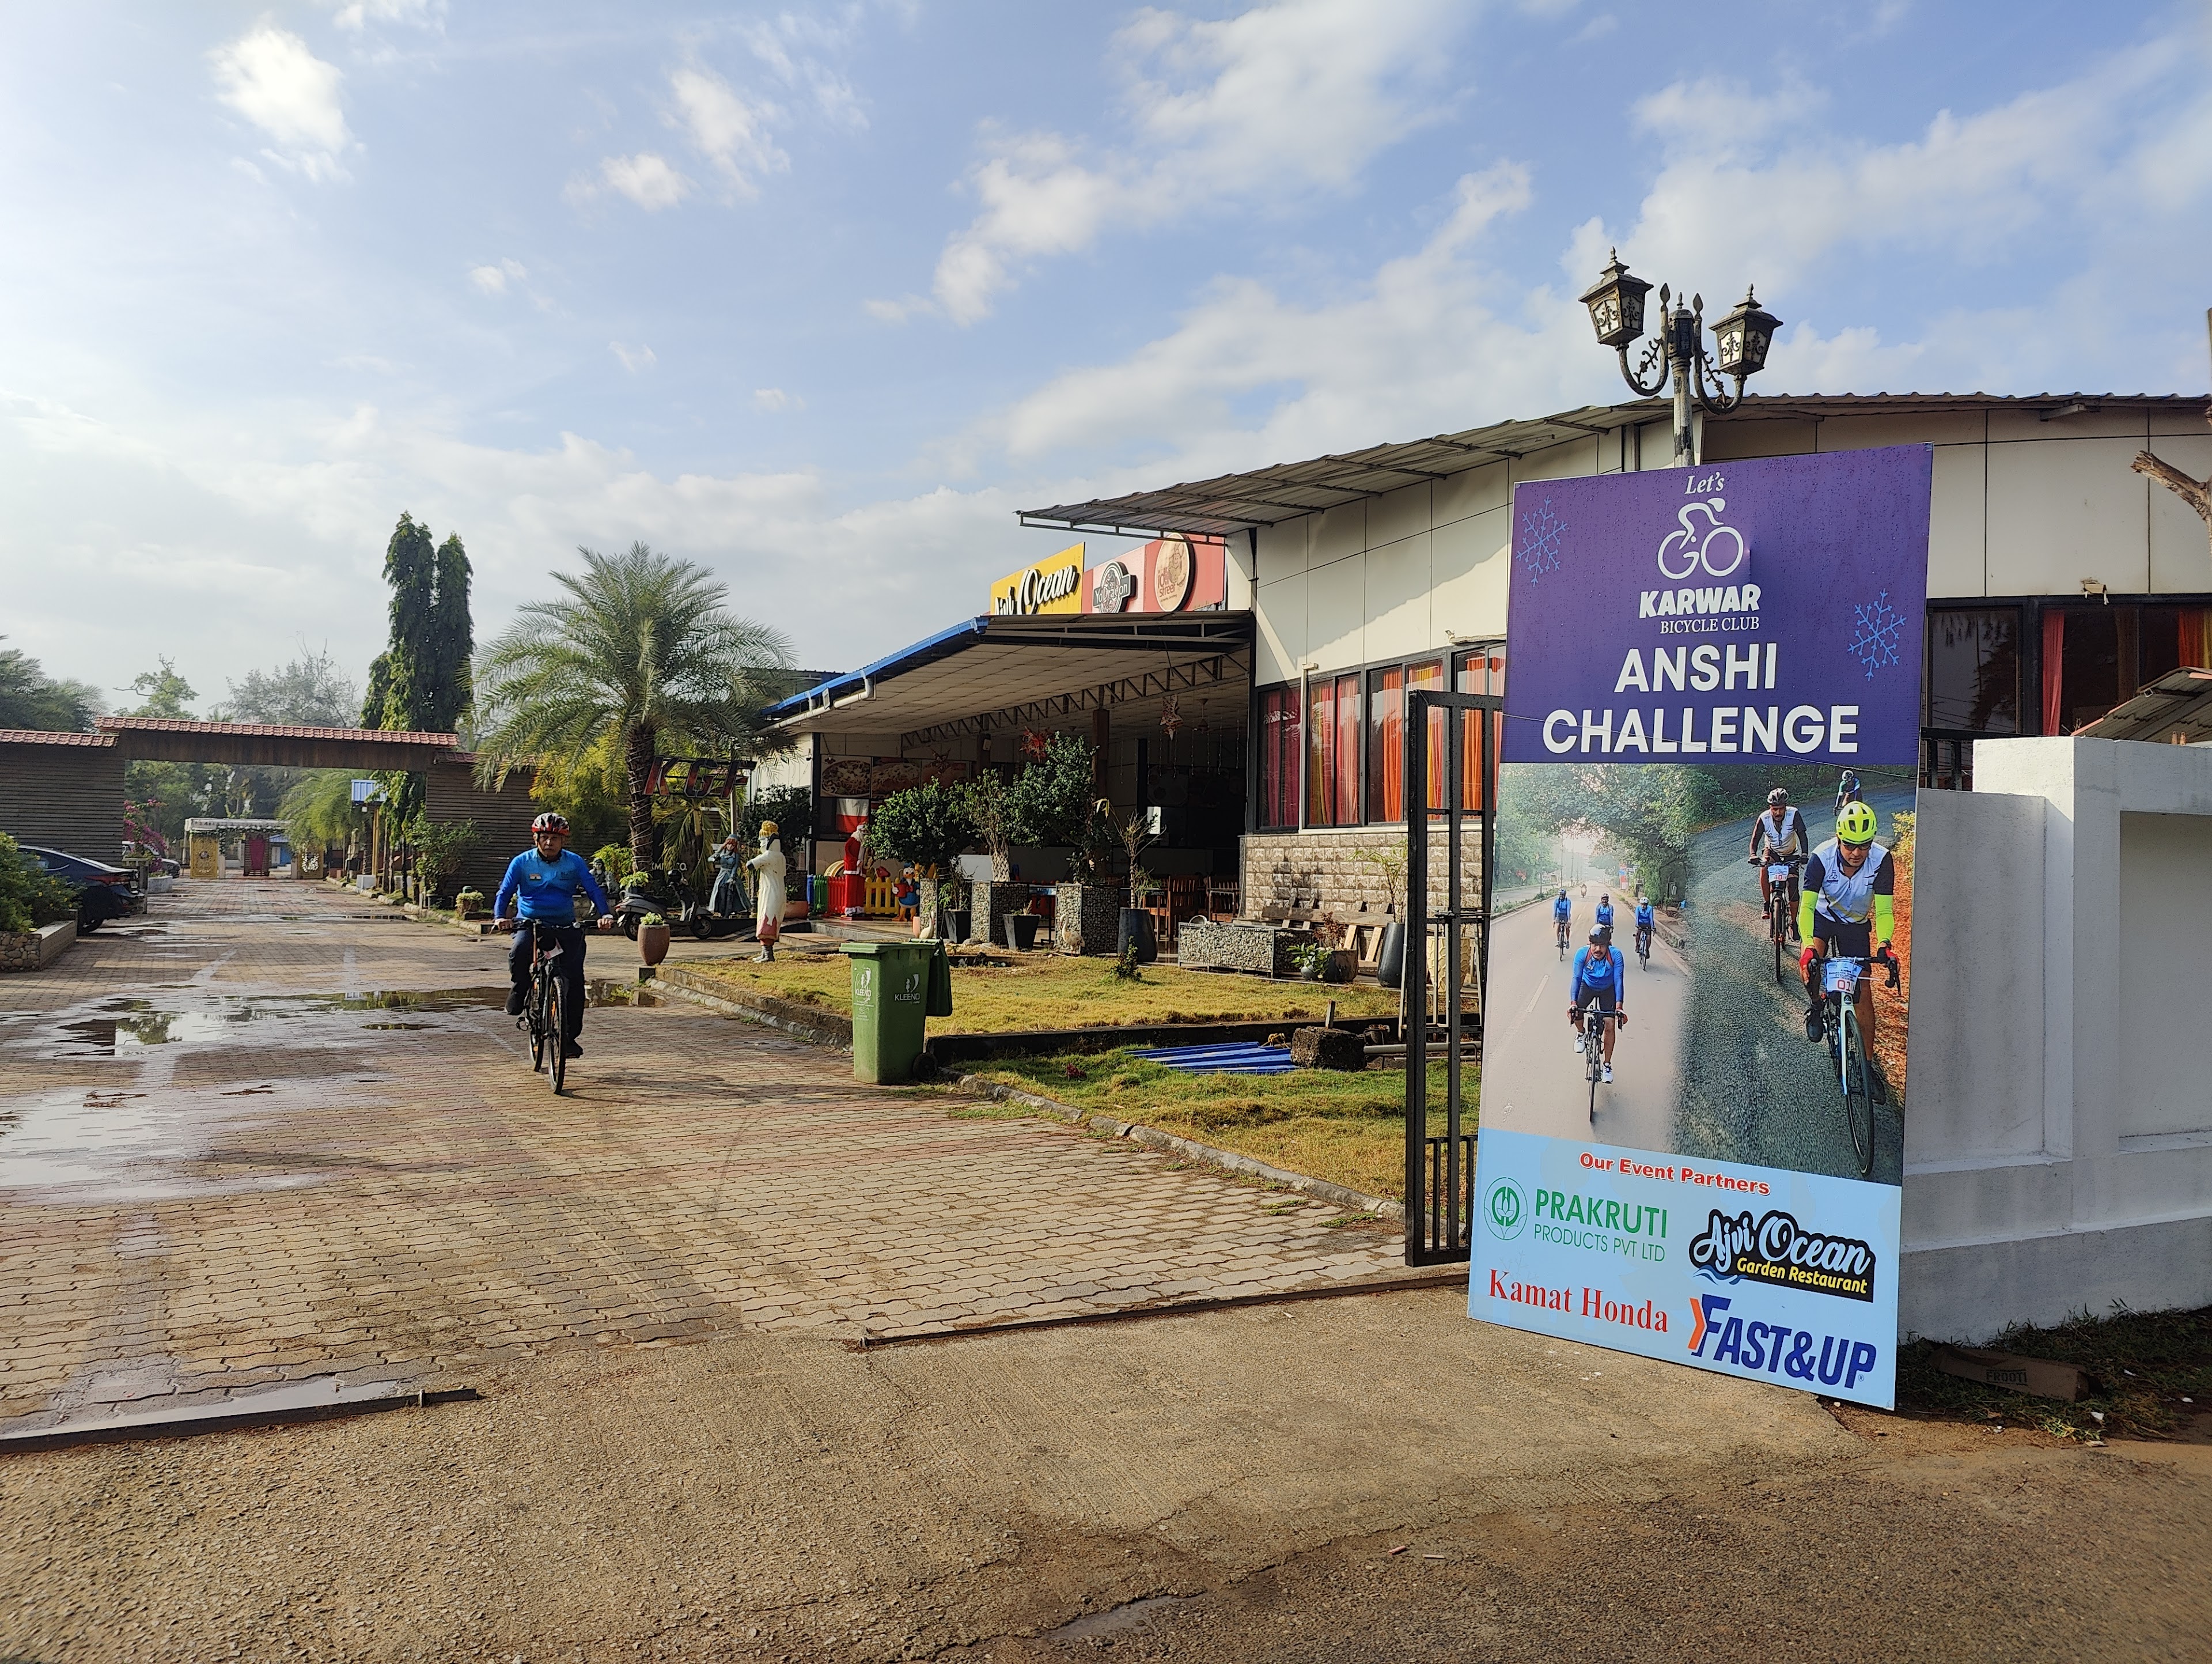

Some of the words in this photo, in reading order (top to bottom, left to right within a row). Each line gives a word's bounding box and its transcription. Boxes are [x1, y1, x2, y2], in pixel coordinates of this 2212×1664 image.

[1684, 472, 1725, 494] Let's
[1017, 565, 1076, 615] Ocean
[1160, 581, 1176, 597] street
[1639, 584, 1761, 618] KARWAR
[1660, 618, 1718, 634] BICYCLE
[1721, 617, 1760, 631] CLUB
[1613, 642, 1778, 693] ANSHI
[1542, 705, 1859, 754] CHALLENGE
[643, 755, 756, 799] KGF
[1838, 980, 1850, 992] 01
[1578, 1152, 1615, 1171] Our
[1618, 1158, 1675, 1181] Event
[1680, 1167, 1771, 1196] Partners
[1535, 1188, 1668, 1239] PRAKRUTI
[1533, 1223, 1608, 1253] PRODUCTS
[1613, 1238, 1637, 1258] PVT
[1642, 1244, 1665, 1262] LTD
[1694, 1215, 1754, 1272] Ajvi
[1759, 1216, 1871, 1275] Ocean
[1737, 1257, 1786, 1280] Garden
[1788, 1266, 1868, 1294] Restaurant
[1488, 1268, 1573, 1313] Kamat
[1581, 1287, 1668, 1333] Honda
[1691, 1294, 1877, 1390] FAST&UP
[1986, 1371, 2027, 1382] FROOTI
